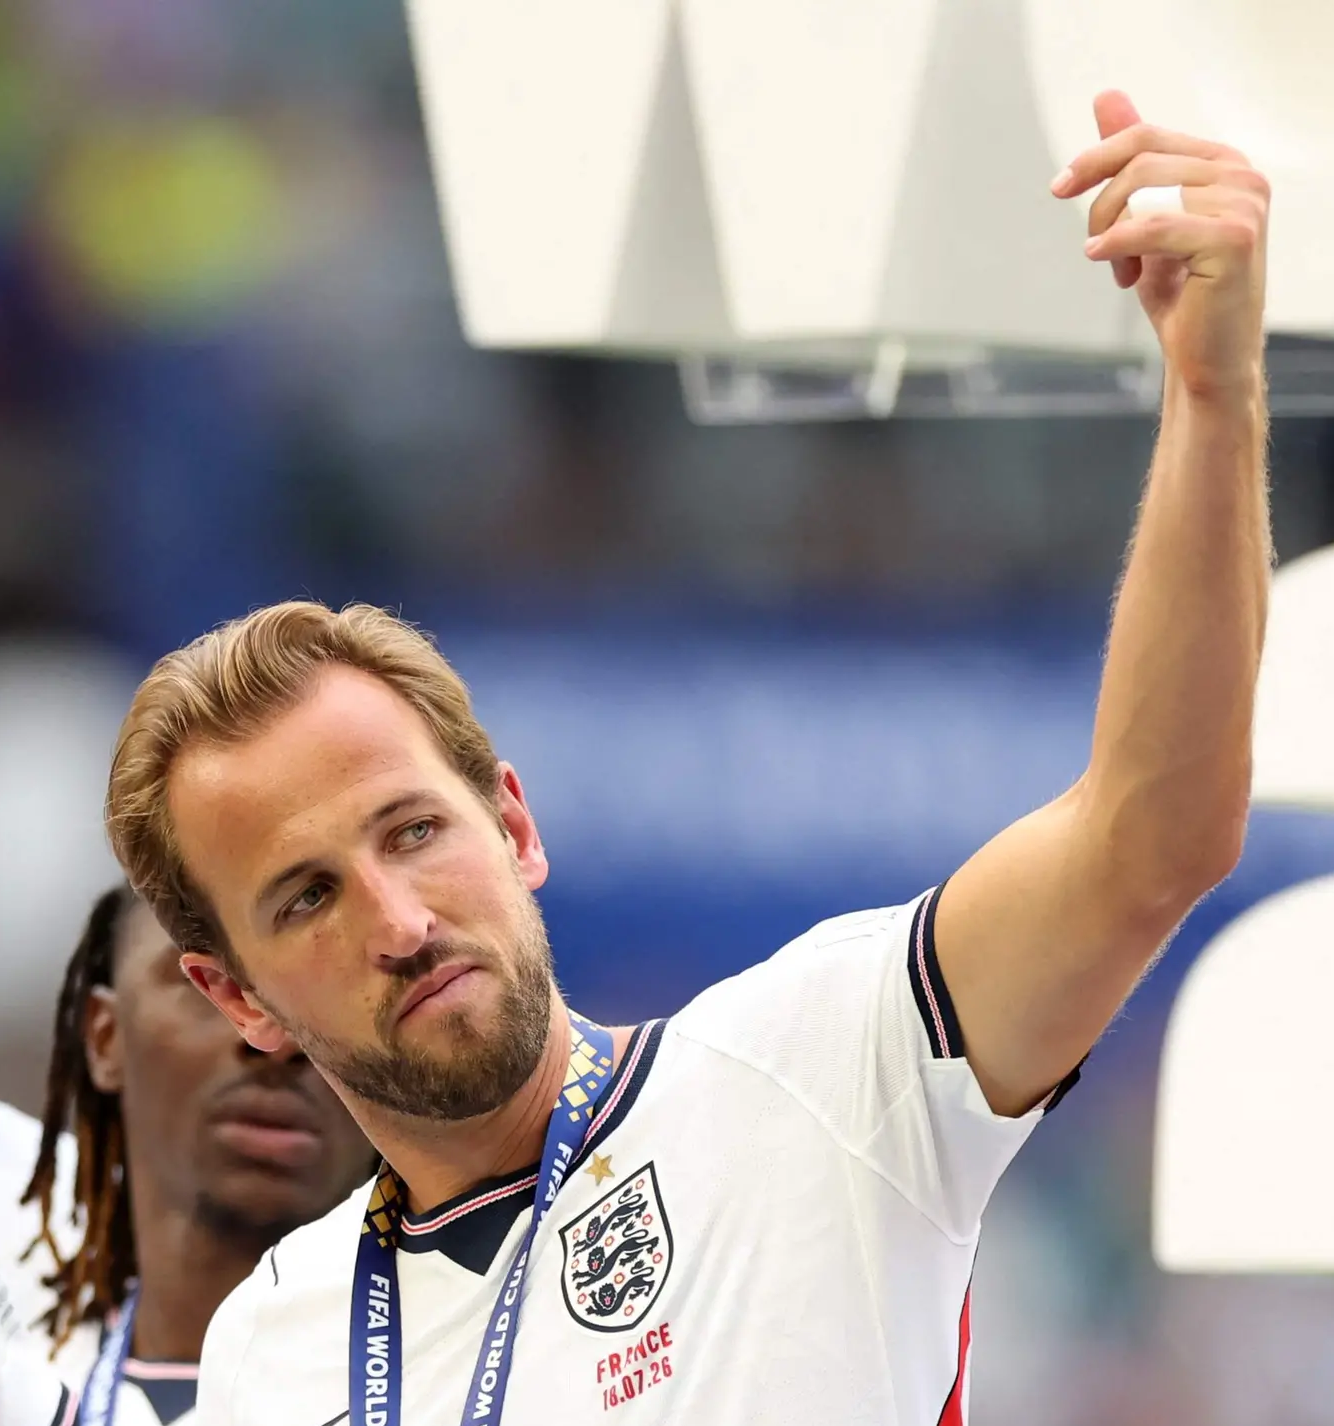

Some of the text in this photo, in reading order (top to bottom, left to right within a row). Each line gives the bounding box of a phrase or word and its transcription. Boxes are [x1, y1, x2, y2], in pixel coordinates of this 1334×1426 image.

[545, 1142, 573, 1202] FIFA
[367, 1272, 391, 1330] FIFA
[472, 1311, 511, 1420] WORLD
[504, 1251, 527, 1307] CUP
[596, 1322, 674, 1384] FRANCE
[602, 1358, 674, 1412] 18.07.26
